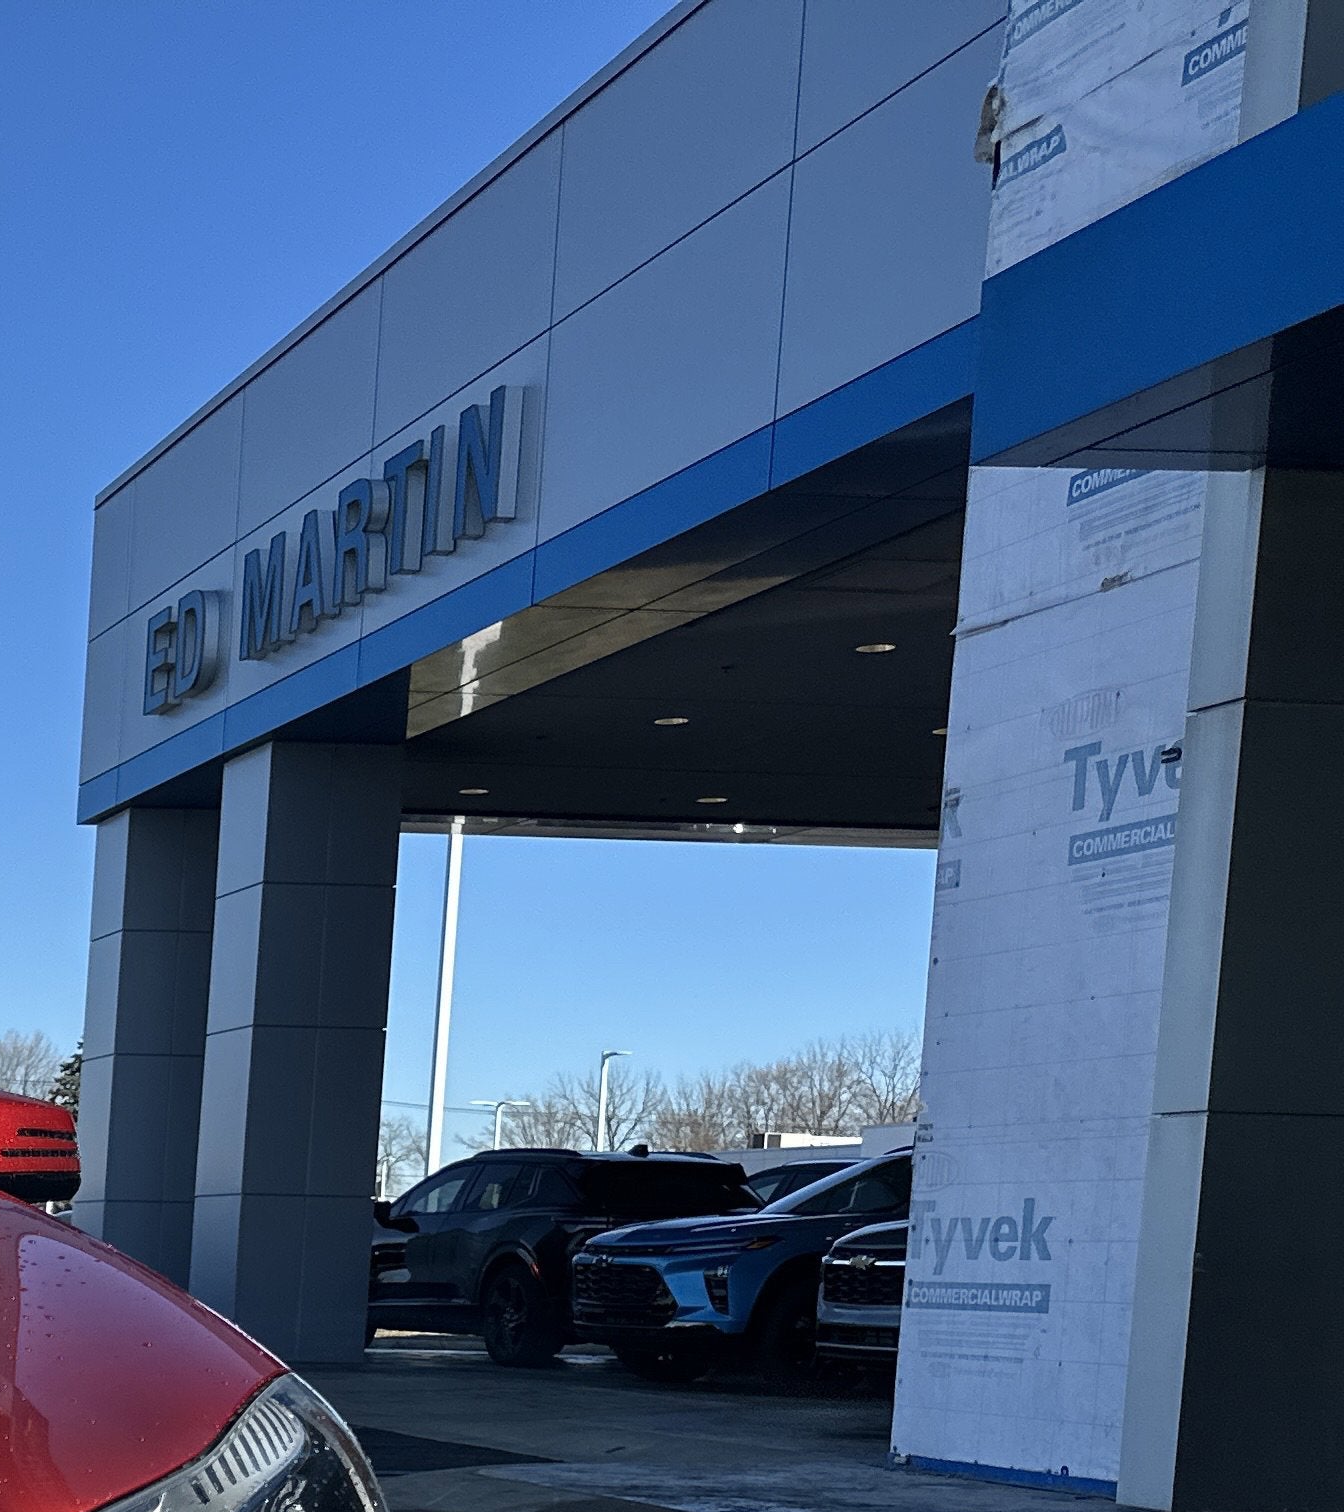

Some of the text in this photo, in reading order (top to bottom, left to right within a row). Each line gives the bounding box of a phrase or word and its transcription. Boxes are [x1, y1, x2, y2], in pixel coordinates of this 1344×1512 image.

[143, 385, 524, 716] ED MARTIN
[912, 1198, 1056, 1276] Tyvek
[912, 1286, 1043, 1307] COMMERCIALWRAP
